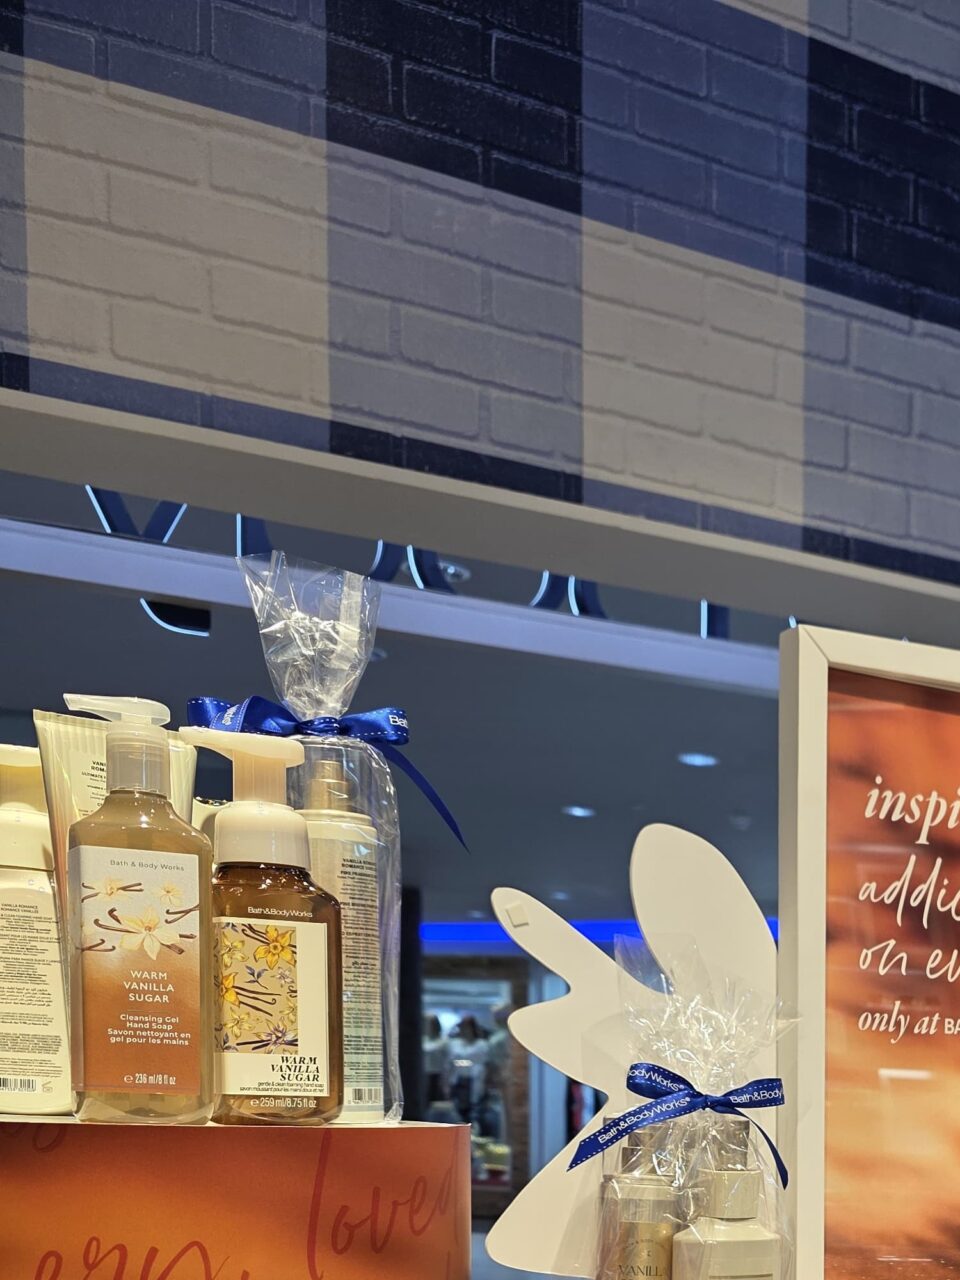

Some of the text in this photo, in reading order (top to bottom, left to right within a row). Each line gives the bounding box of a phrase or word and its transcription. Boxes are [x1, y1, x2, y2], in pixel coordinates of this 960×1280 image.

[110, 859, 129, 868] Bath
[138, 862, 158, 870] Body
[160, 863, 185, 871] Works
[858, 938, 909, 976] on
[130, 970, 168, 981] WARM
[123, 981, 175, 992] VANILLA
[129, 993, 169, 1003] SUGAR
[120, 1014, 163, 1023] Cleansing
[857, 1001, 909, 1044] only
[913, 1012, 942, 1035] at
[126, 1021, 150, 1029] Hand
[108, 1028, 134, 1036] Savon
[136, 1030, 179, 1040] nettoyant
[110, 1035, 124, 1044] gel
[126, 1037, 147, 1045] pour
[163, 1038, 189, 1046] mains
[281, 1056, 318, 1065] WARM
[271, 1064, 320, 1074] VANILLA
[135, 1073, 148, 1084] 236
[280, 1073, 320, 1082] SUGAR
[260, 1097, 274, 1107] 259
